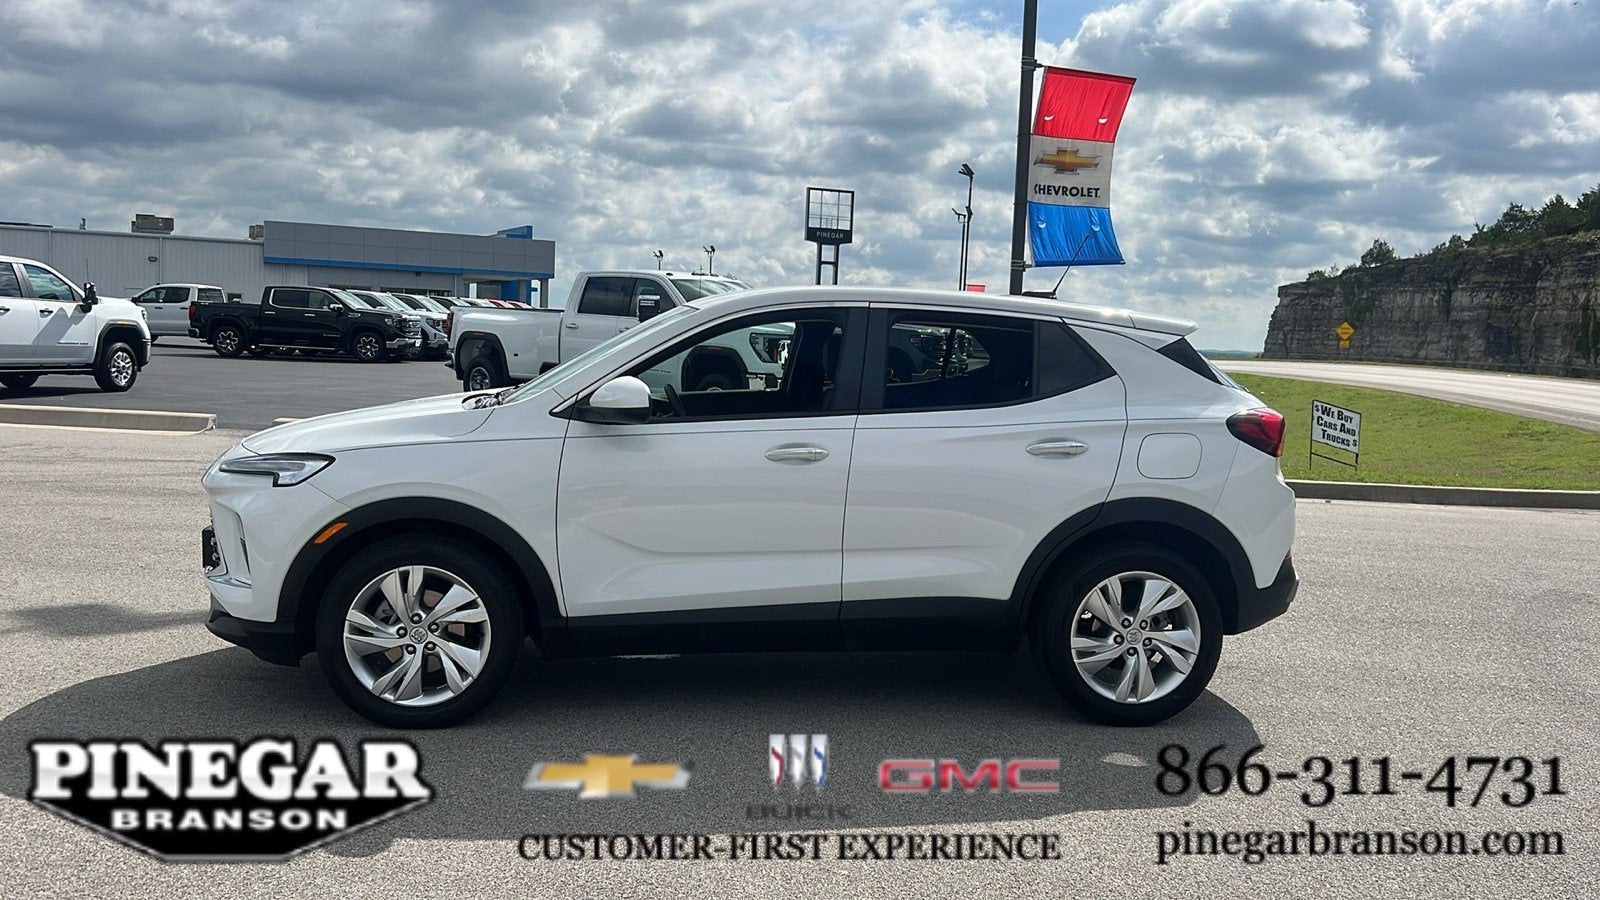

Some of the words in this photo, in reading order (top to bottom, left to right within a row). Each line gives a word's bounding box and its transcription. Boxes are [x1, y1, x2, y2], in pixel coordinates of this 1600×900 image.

[1034, 184, 1100, 198] CHEVROLET
[816, 231, 844, 239] PINEGAR
[1337, 410, 1353, 423] BUY
[1317, 416, 1338, 431] CARS
[1339, 423, 1356, 437] AND
[1321, 429, 1350, 447] TRUCKS
